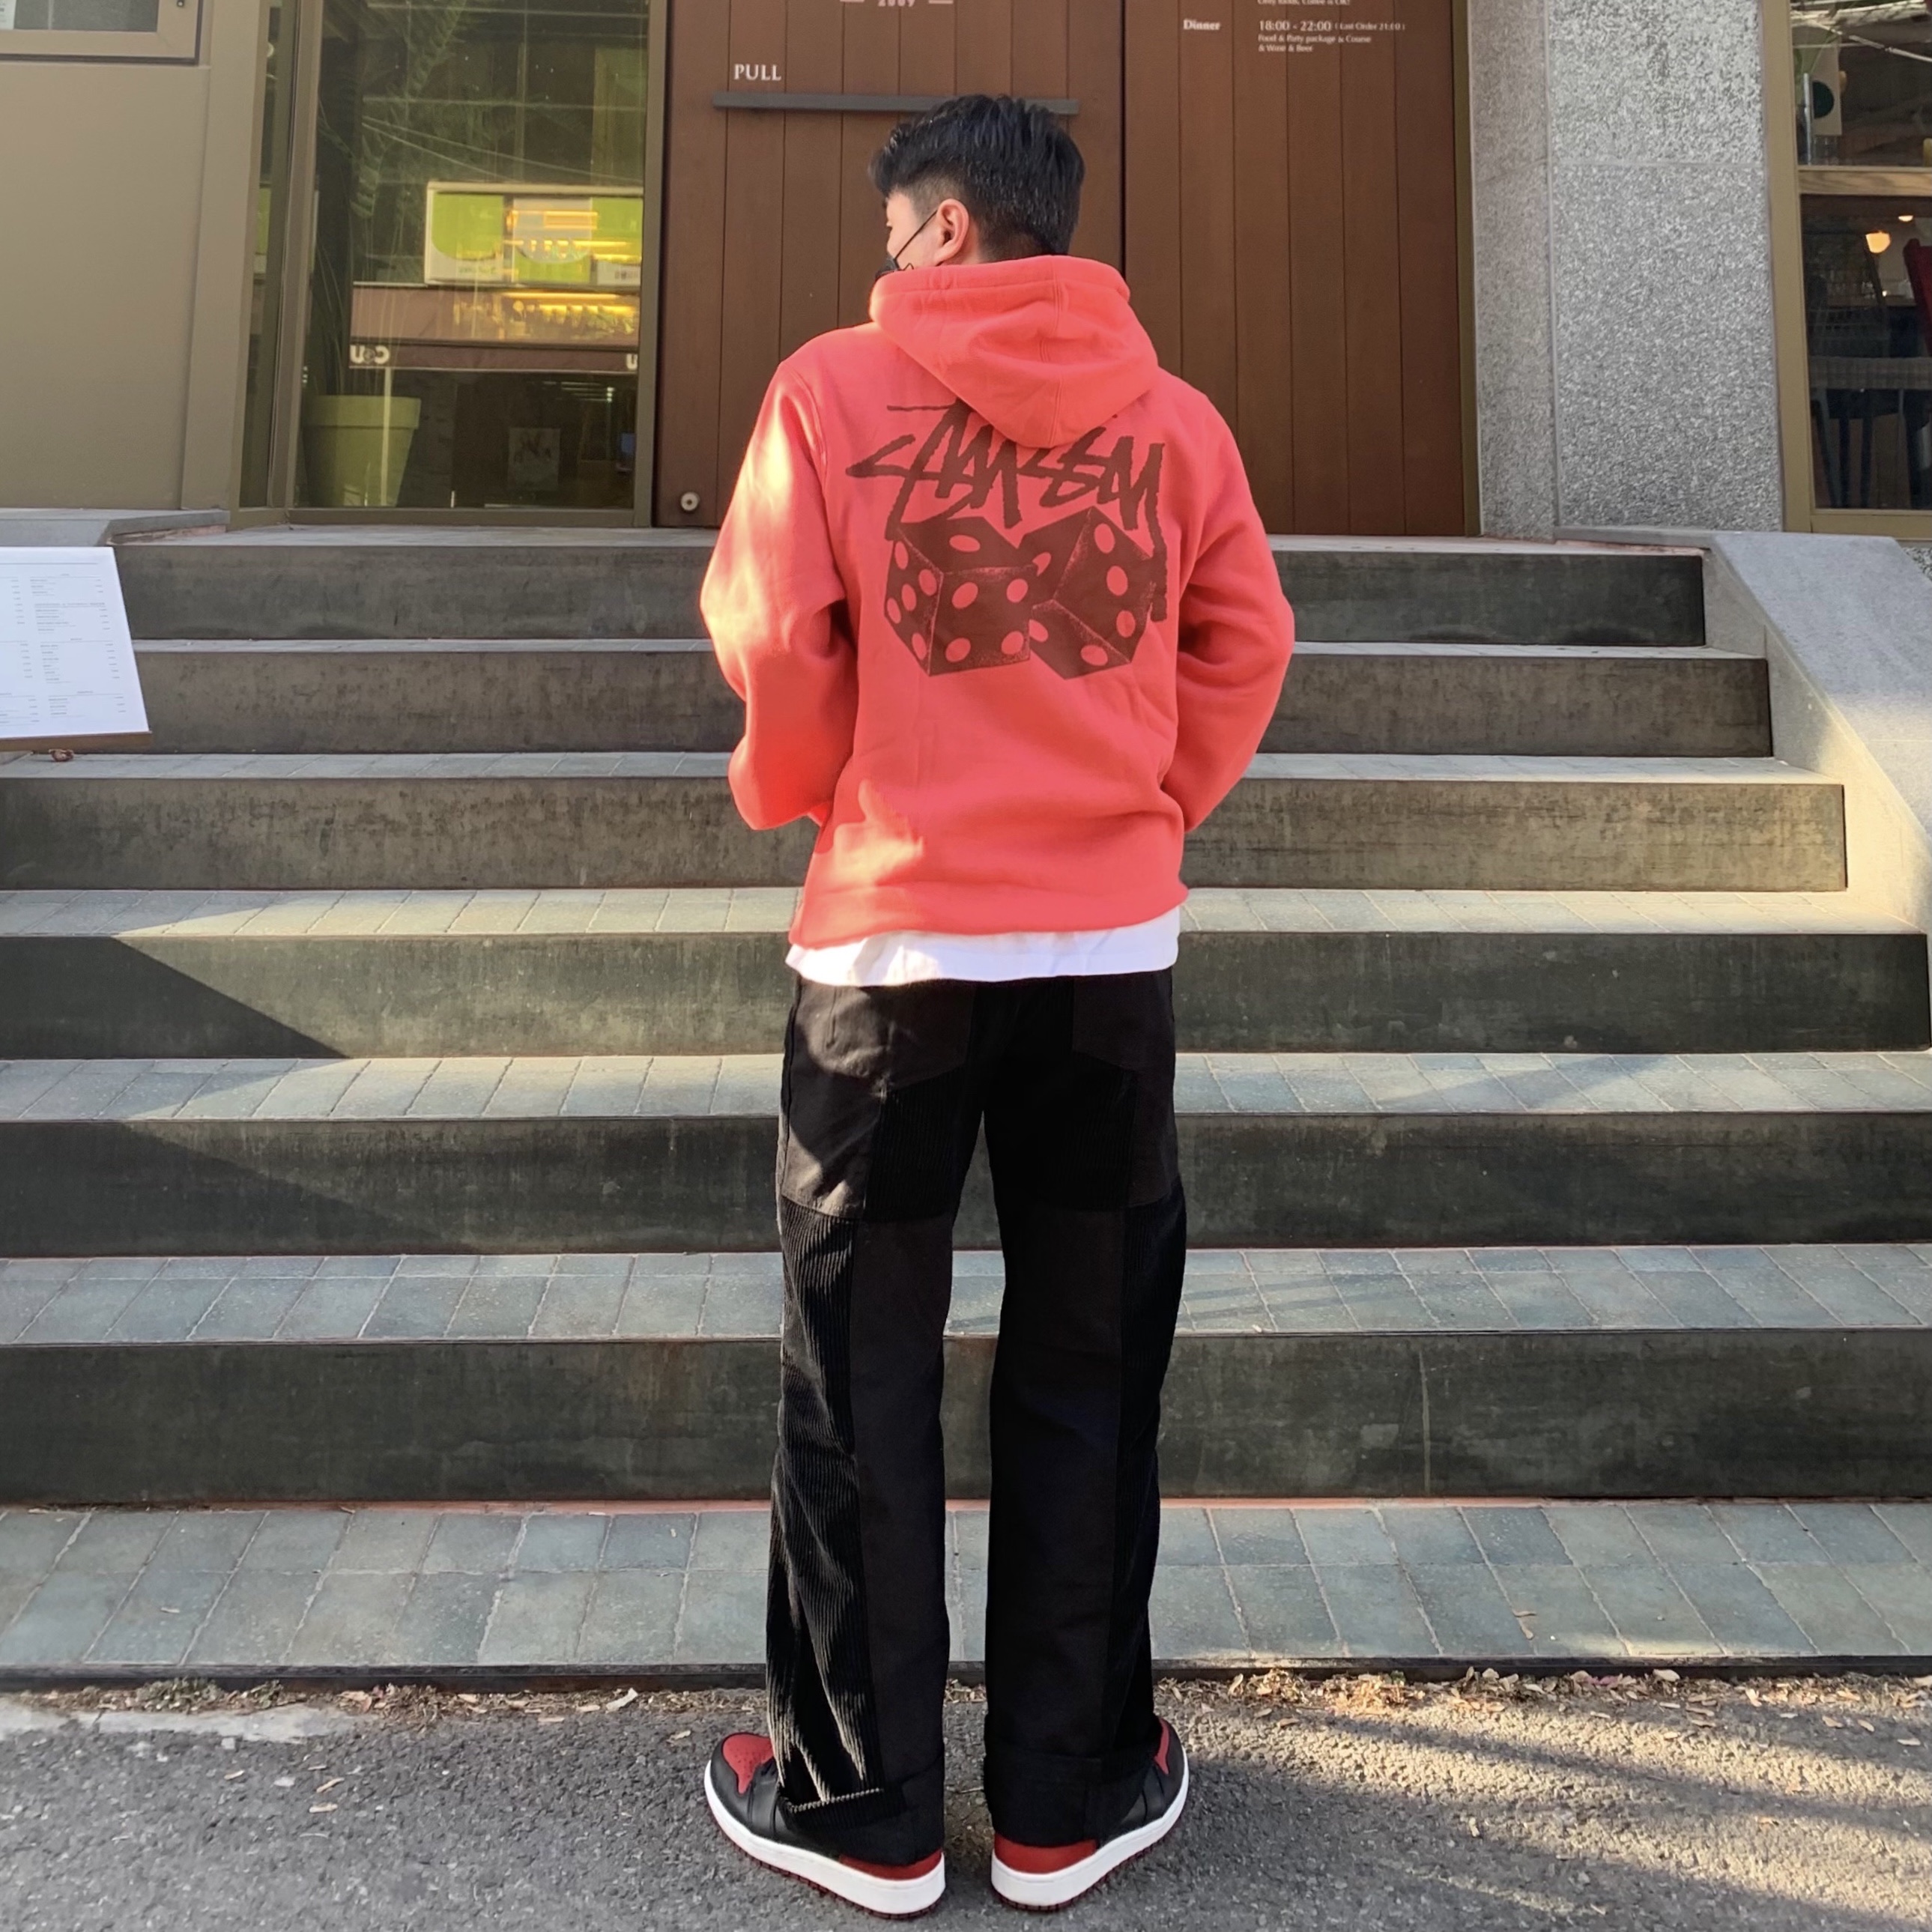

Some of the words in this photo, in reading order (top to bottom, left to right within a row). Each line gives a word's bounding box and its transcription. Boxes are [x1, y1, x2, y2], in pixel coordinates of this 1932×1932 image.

[1183, 19, 1221, 31] Dinner
[1259, 20, 1290, 31] 18:00
[1300, 20, 1331, 31] 22:00
[1355, 22, 1377, 30] Order
[1258, 34, 1277, 42] Food
[1306, 34, 1336, 44] package
[734, 64, 782, 80] PULL
